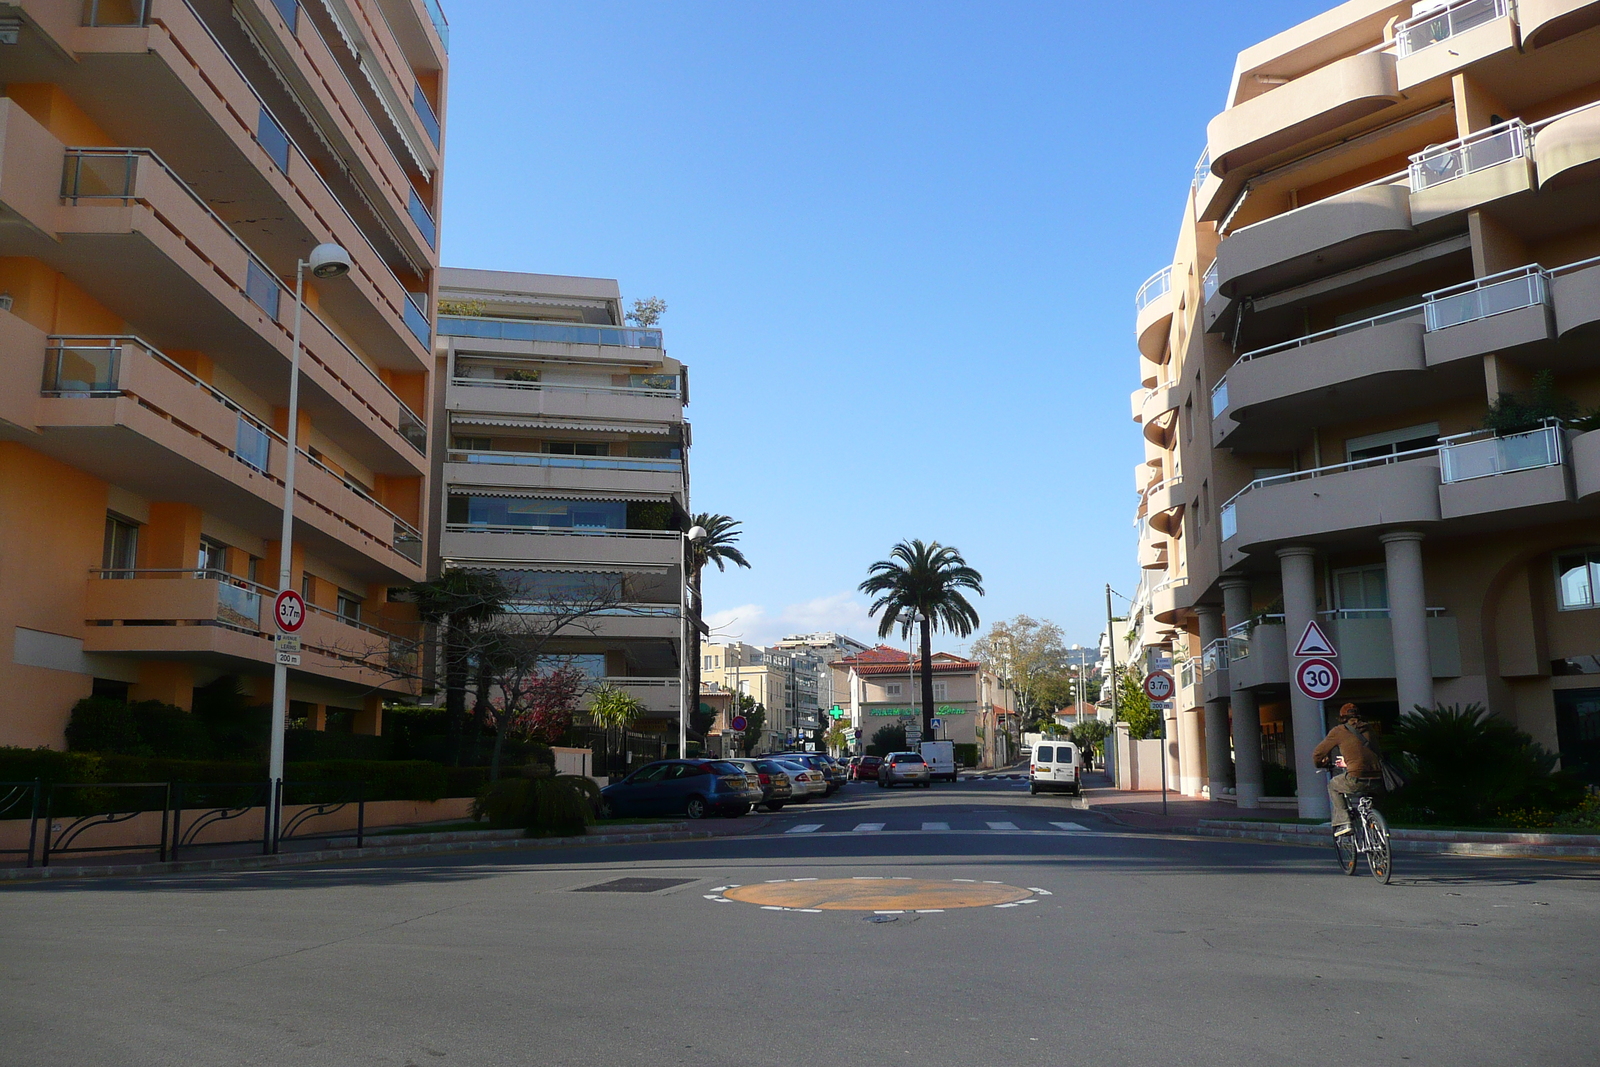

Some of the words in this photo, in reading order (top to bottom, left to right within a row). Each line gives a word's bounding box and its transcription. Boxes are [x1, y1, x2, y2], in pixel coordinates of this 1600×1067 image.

[281, 604, 300, 618] 3.7m
[280, 654, 290, 662] 200
[1306, 670, 1330, 687] 30
[1150, 681, 1168, 689] 3.7m
